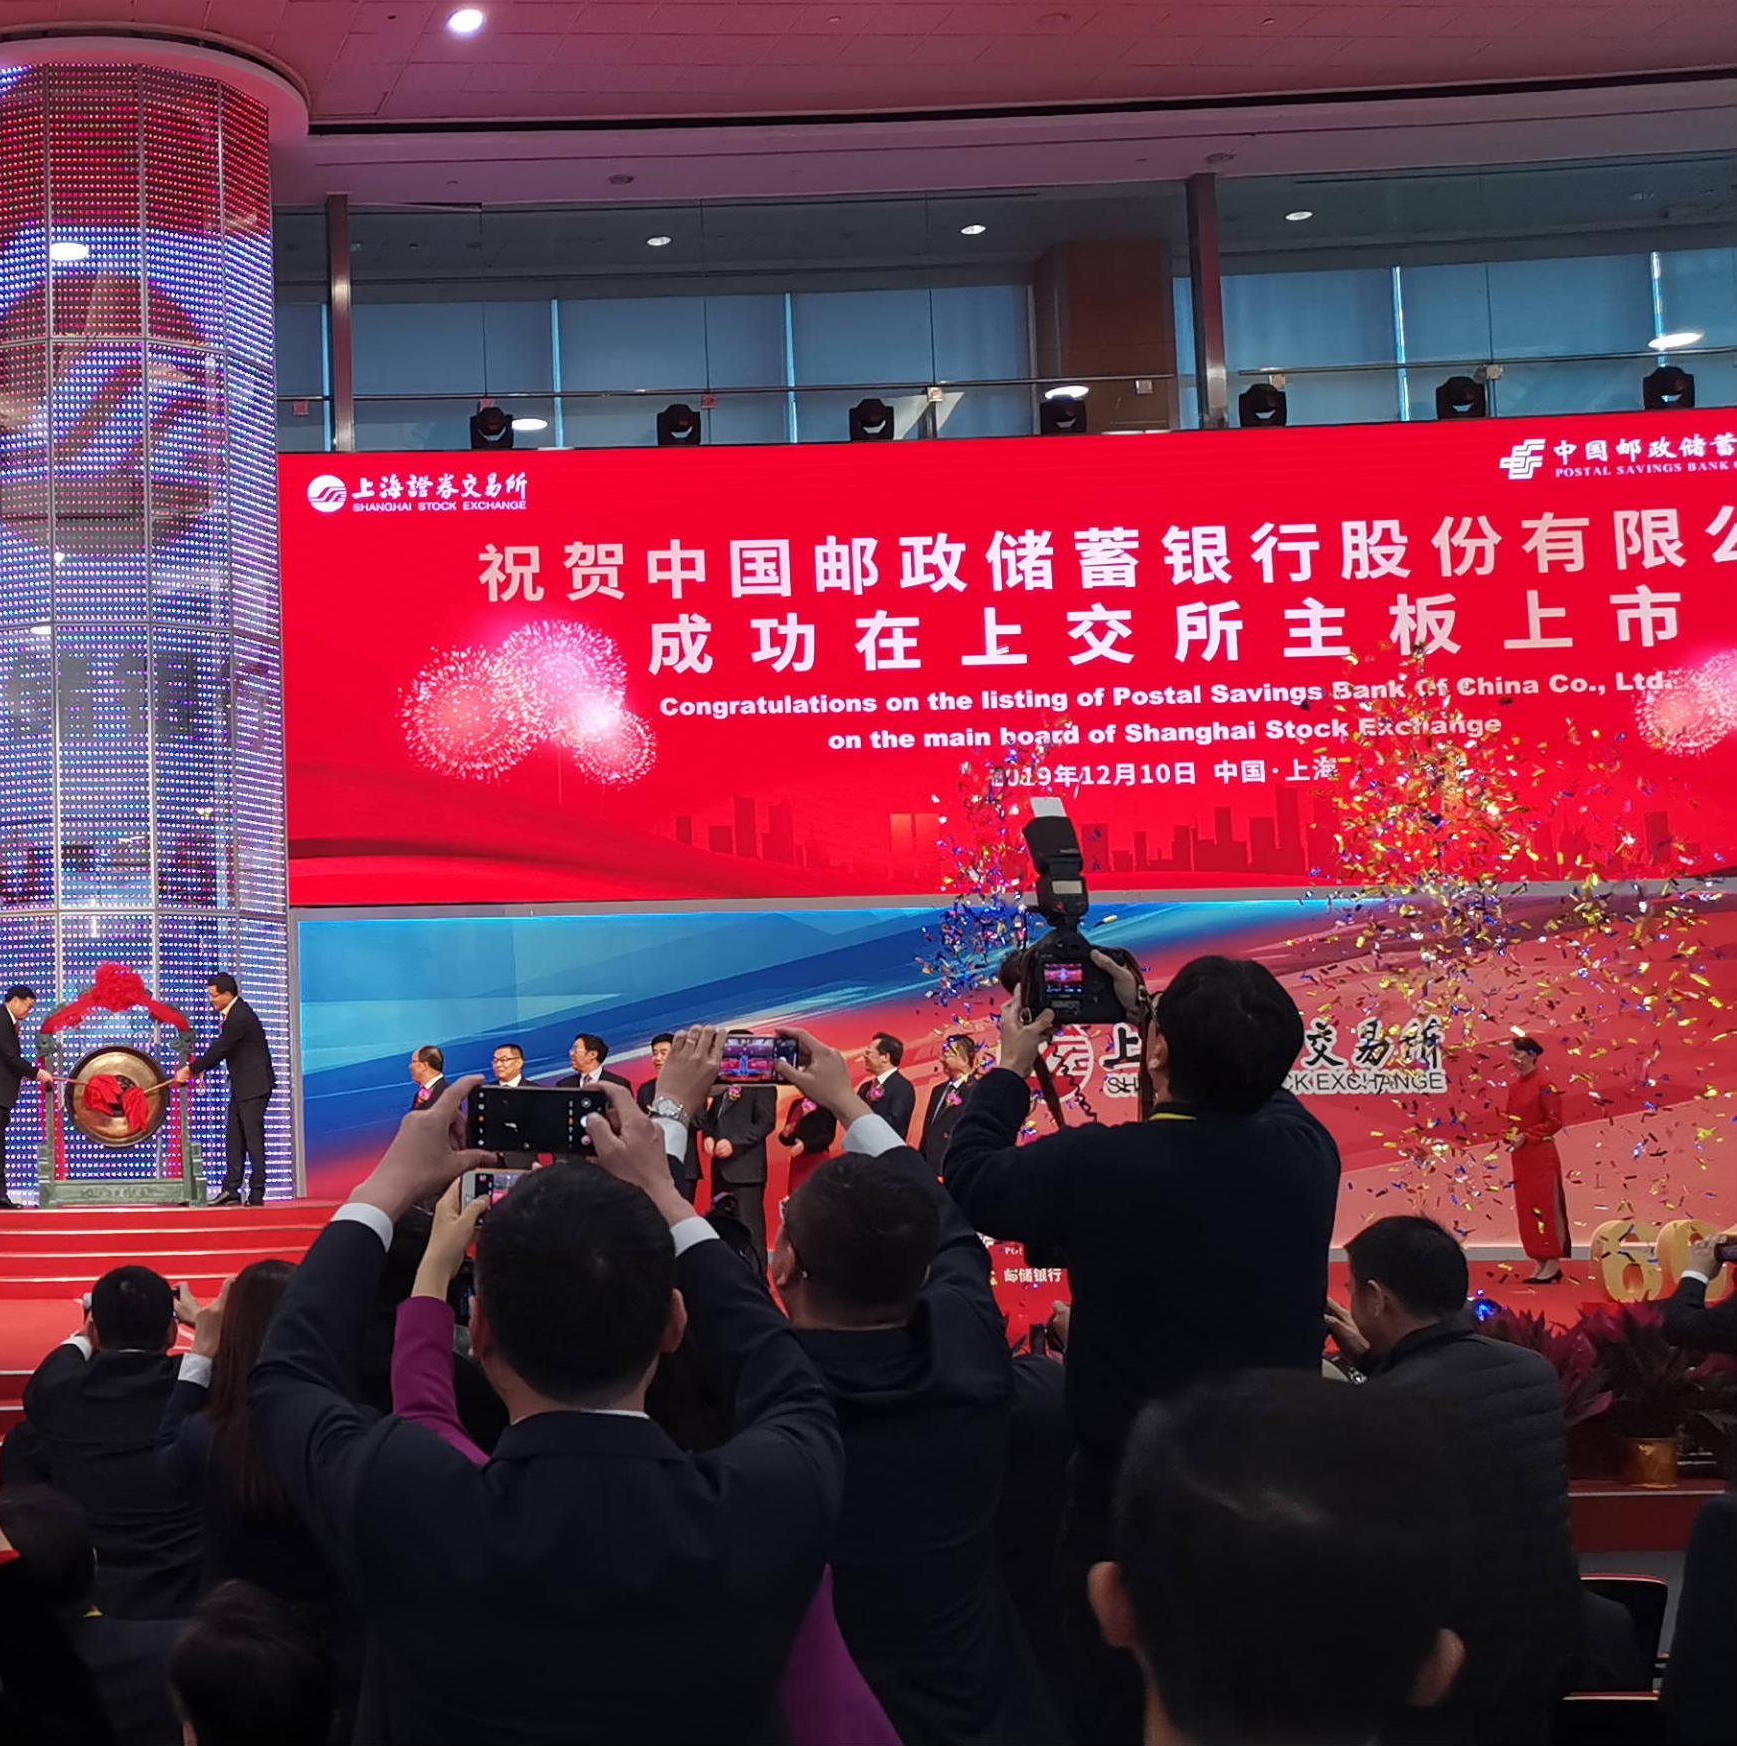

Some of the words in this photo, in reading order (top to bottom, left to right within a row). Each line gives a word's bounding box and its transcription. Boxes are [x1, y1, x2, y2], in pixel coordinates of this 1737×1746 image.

[1555, 466, 1609, 478] POSTAL
[1616, 463, 1682, 475] SAVINGS
[1687, 461, 1729, 472] BANK
[353, 502, 412, 512] SHANGHAI
[417, 501, 457, 511] STOCK
[462, 500, 527, 511] EXCHANGE
[648, 585, 1682, 675] 成功在上交所主板上市
[660, 694, 878, 719] Congratulations
[885, 696, 919, 712] on
[926, 691, 973, 711] the
[981, 690, 1068, 712] listing
[1076, 687, 1105, 707] of
[1113, 685, 1202, 706] Postal
[1210, 683, 1323, 705] Savings
[1332, 680, 1407, 700] Bank
[1416, 678, 1449, 697] Of
[1456, 676, 1540, 696] China
[1549, 674, 1606, 696] Co.,
[1615, 671, 1673, 692] Ltd.
[828, 734, 862, 750] on
[869, 729, 916, 749] the
[923, 727, 991, 748] main
[1000, 726, 1080, 746] board
[1088, 724, 1117, 744] of
[1124, 720, 1256, 746] Shanghai
[1265, 718, 1349, 740] Stock
[1357, 718, 1503, 739] Exchange
[1316, 1072, 1445, 1092] EXCHANGE
